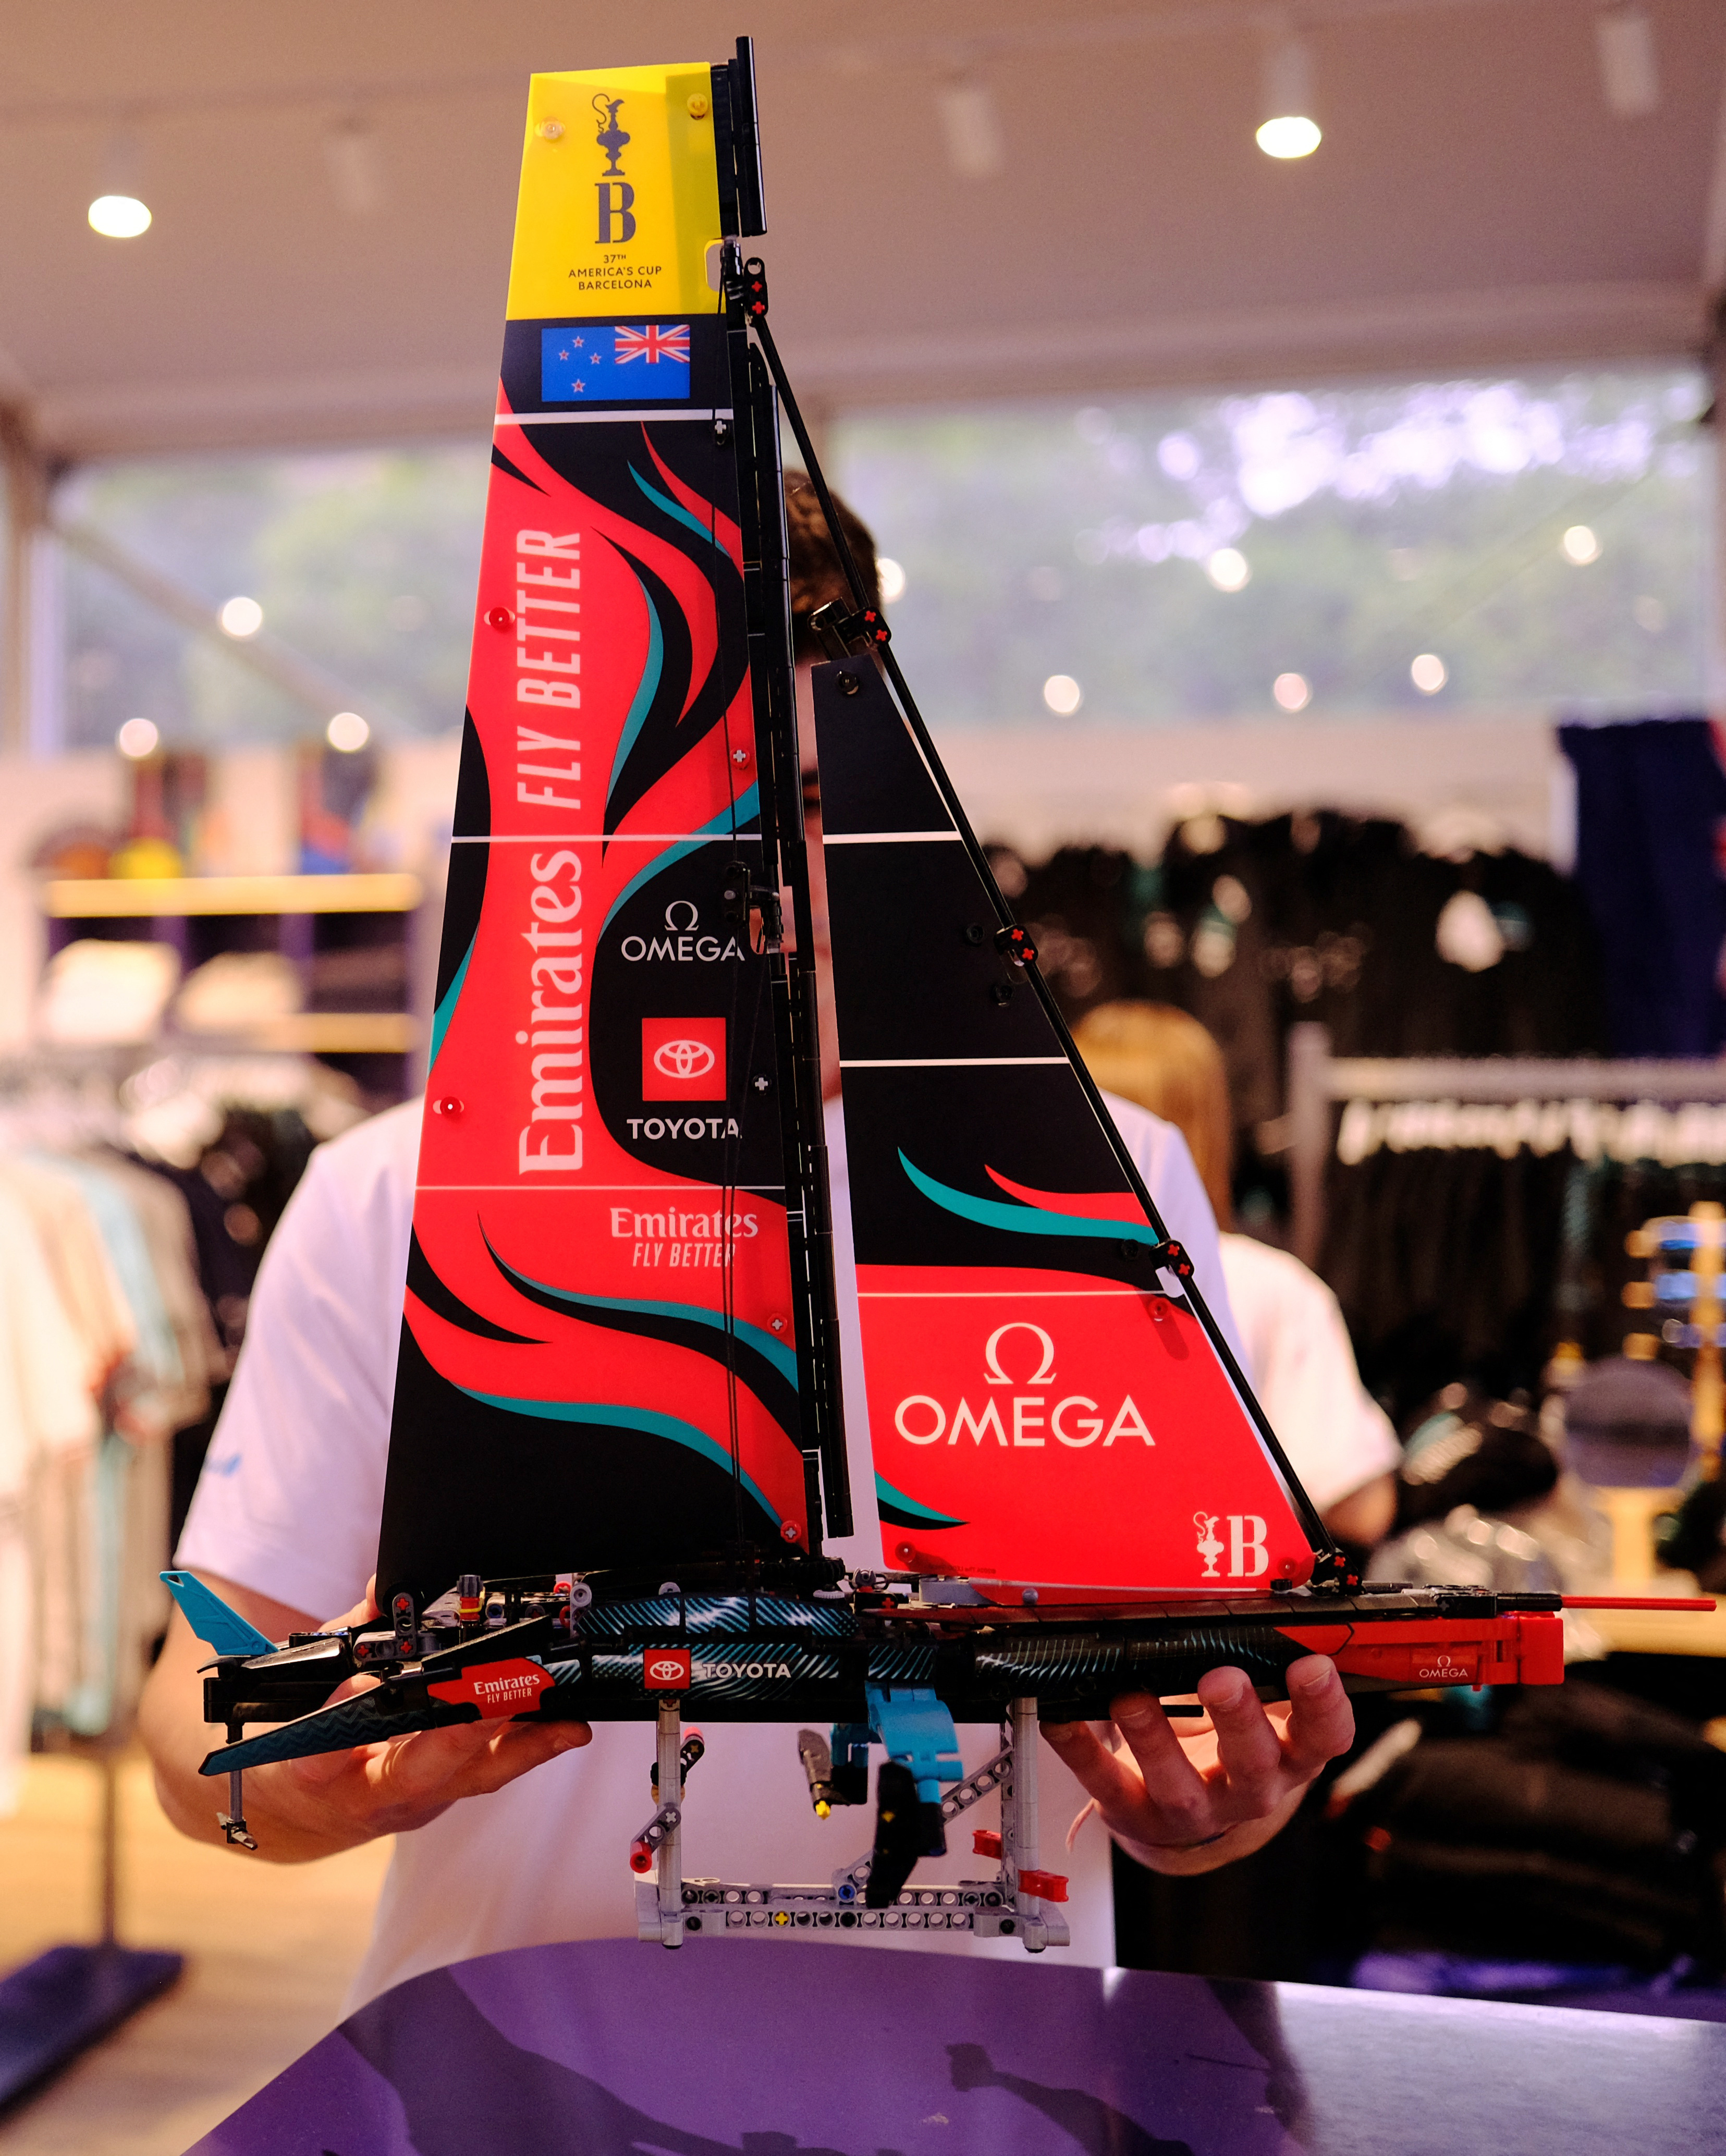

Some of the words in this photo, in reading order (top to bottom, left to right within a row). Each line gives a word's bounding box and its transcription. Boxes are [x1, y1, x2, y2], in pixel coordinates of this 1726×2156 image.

[594, 182, 636, 244] B
[604, 254, 626, 263] 37TH
[568, 266, 633, 278] AMERICA'S
[638, 266, 662, 275] CUP
[579, 279, 652, 290] BARCELONA
[517, 529, 581, 709] BETTER
[517, 726, 581, 810] FLY
[621, 936, 745, 962] OMEGA
[515, 849, 583, 1175] Emirates
[626, 1118, 743, 1140] TOYOTA
[609, 1206, 758, 1238] Emirates
[632, 1243, 664, 1267] FLY
[894, 1394, 1156, 1448] OMEGA
[1227, 1515, 1269, 1578] B
[702, 1663, 792, 1679] TOYOTA
[1419, 1668, 1468, 1678] OMEGA
[473, 1674, 540, 1695] Emirates
[487, 1693, 500, 1704] FLY
[503, 1687, 532, 1701] BETTER
